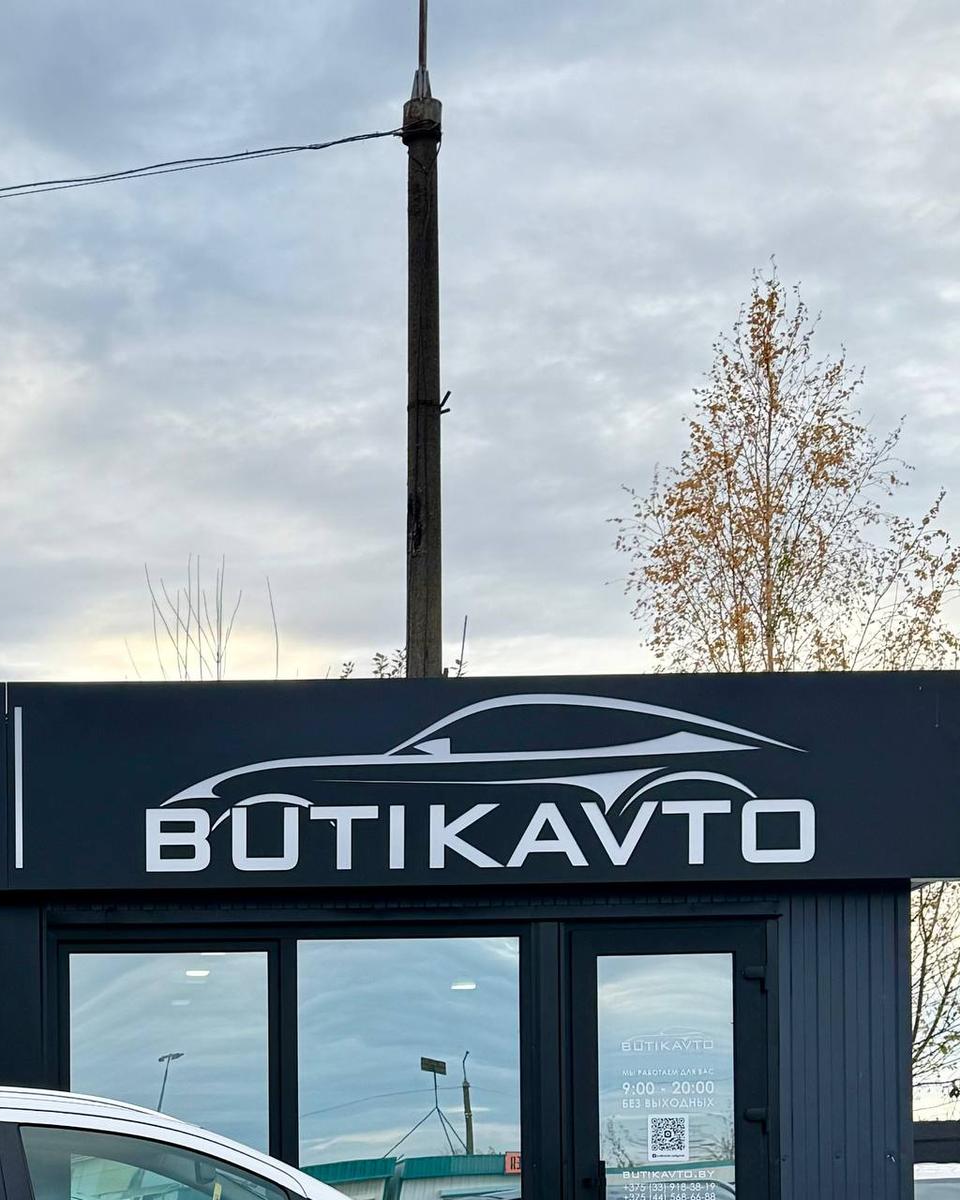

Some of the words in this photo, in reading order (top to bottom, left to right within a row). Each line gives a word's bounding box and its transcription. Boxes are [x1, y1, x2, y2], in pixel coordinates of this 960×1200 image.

[145, 798, 816, 872] BUTIKAVTO
[621, 1040, 714, 1051] BUTIKAVTO
[622, 1082, 655, 1095] 9:00
[672, 1081, 714, 1095] 20:00
[622, 1099, 641, 1109] БЕЗ
[644, 1098, 714, 1109] ВЫХОДНЫХ
[622, 1170, 715, 1179] BUTIKAVTO.BY
[623, 1183, 646, 1192] +375
[649, 1183, 667, 1193] (33)
[669, 1182, 716, 1191] 918-38-19
